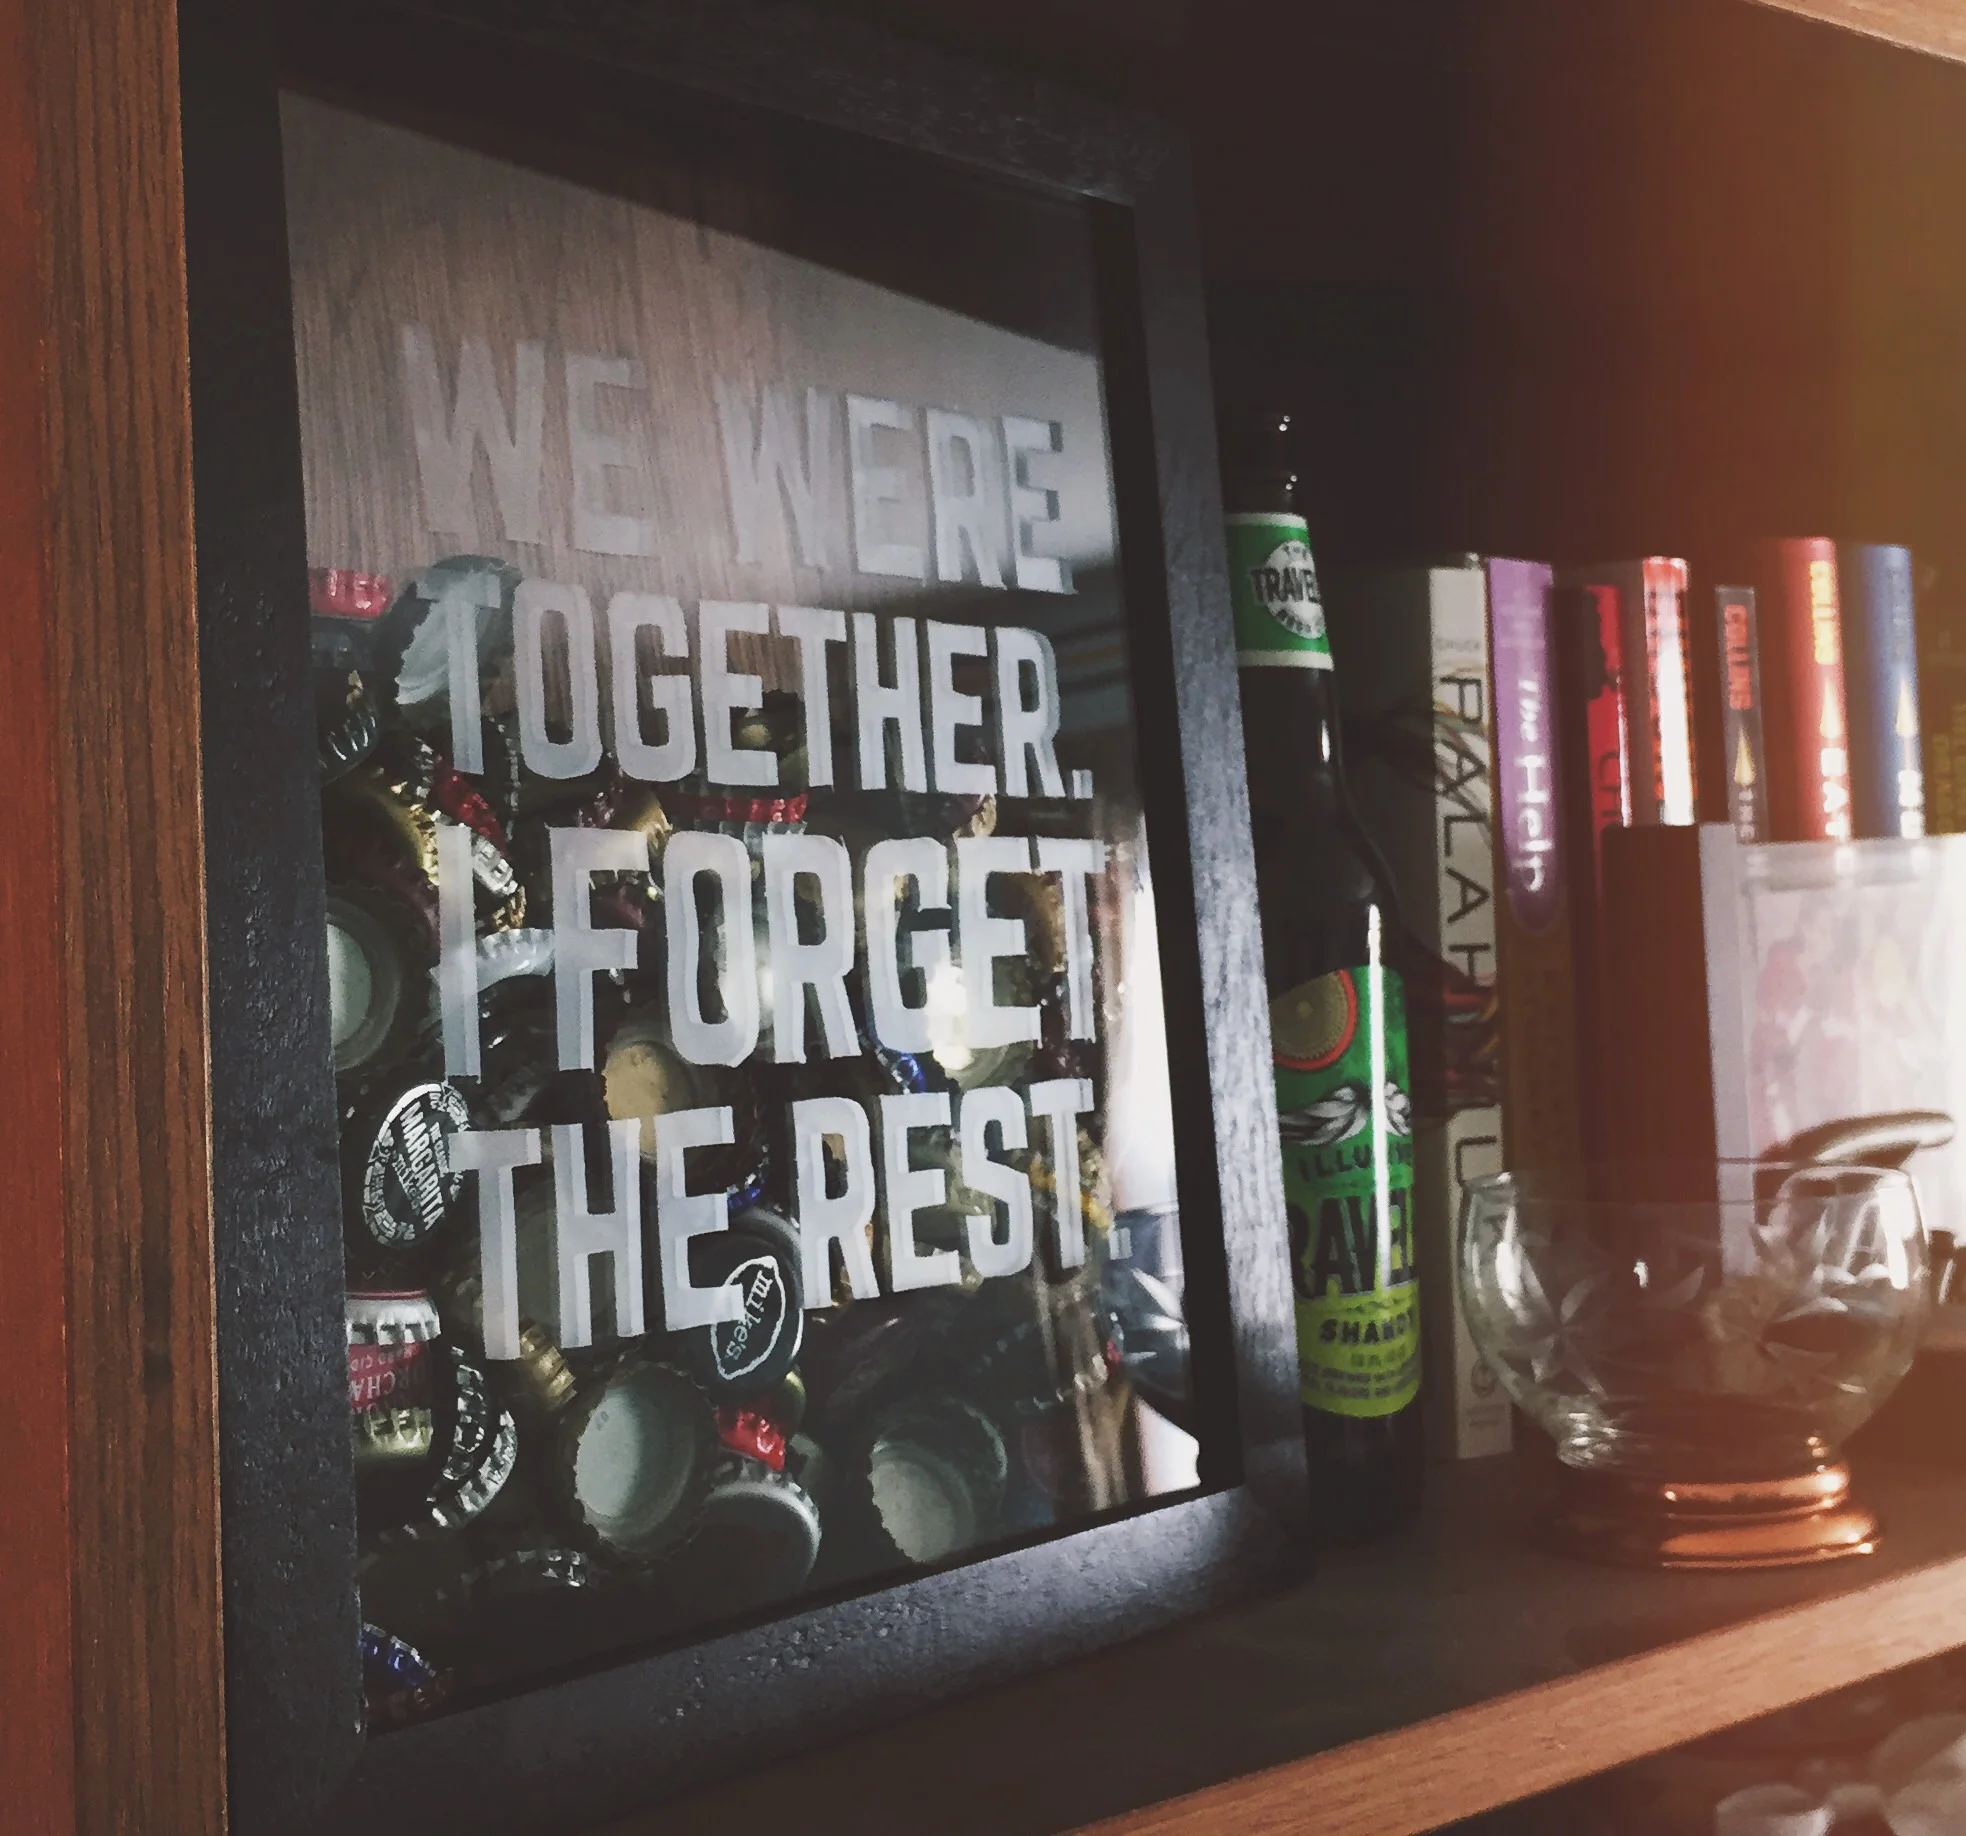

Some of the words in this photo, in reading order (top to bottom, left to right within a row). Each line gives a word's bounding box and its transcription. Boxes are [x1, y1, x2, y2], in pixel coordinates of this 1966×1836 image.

[403, 322, 656, 559] WE
[713, 373, 1078, 595] WERE
[414, 566, 1093, 800] TOGETHER.
[436, 825, 481, 1081] I
[547, 825, 1107, 1068] FORGET
[400, 1101, 445, 1231] MARGARITA
[448, 1106, 743, 1361] THE
[793, 1078, 1133, 1310] REST.
